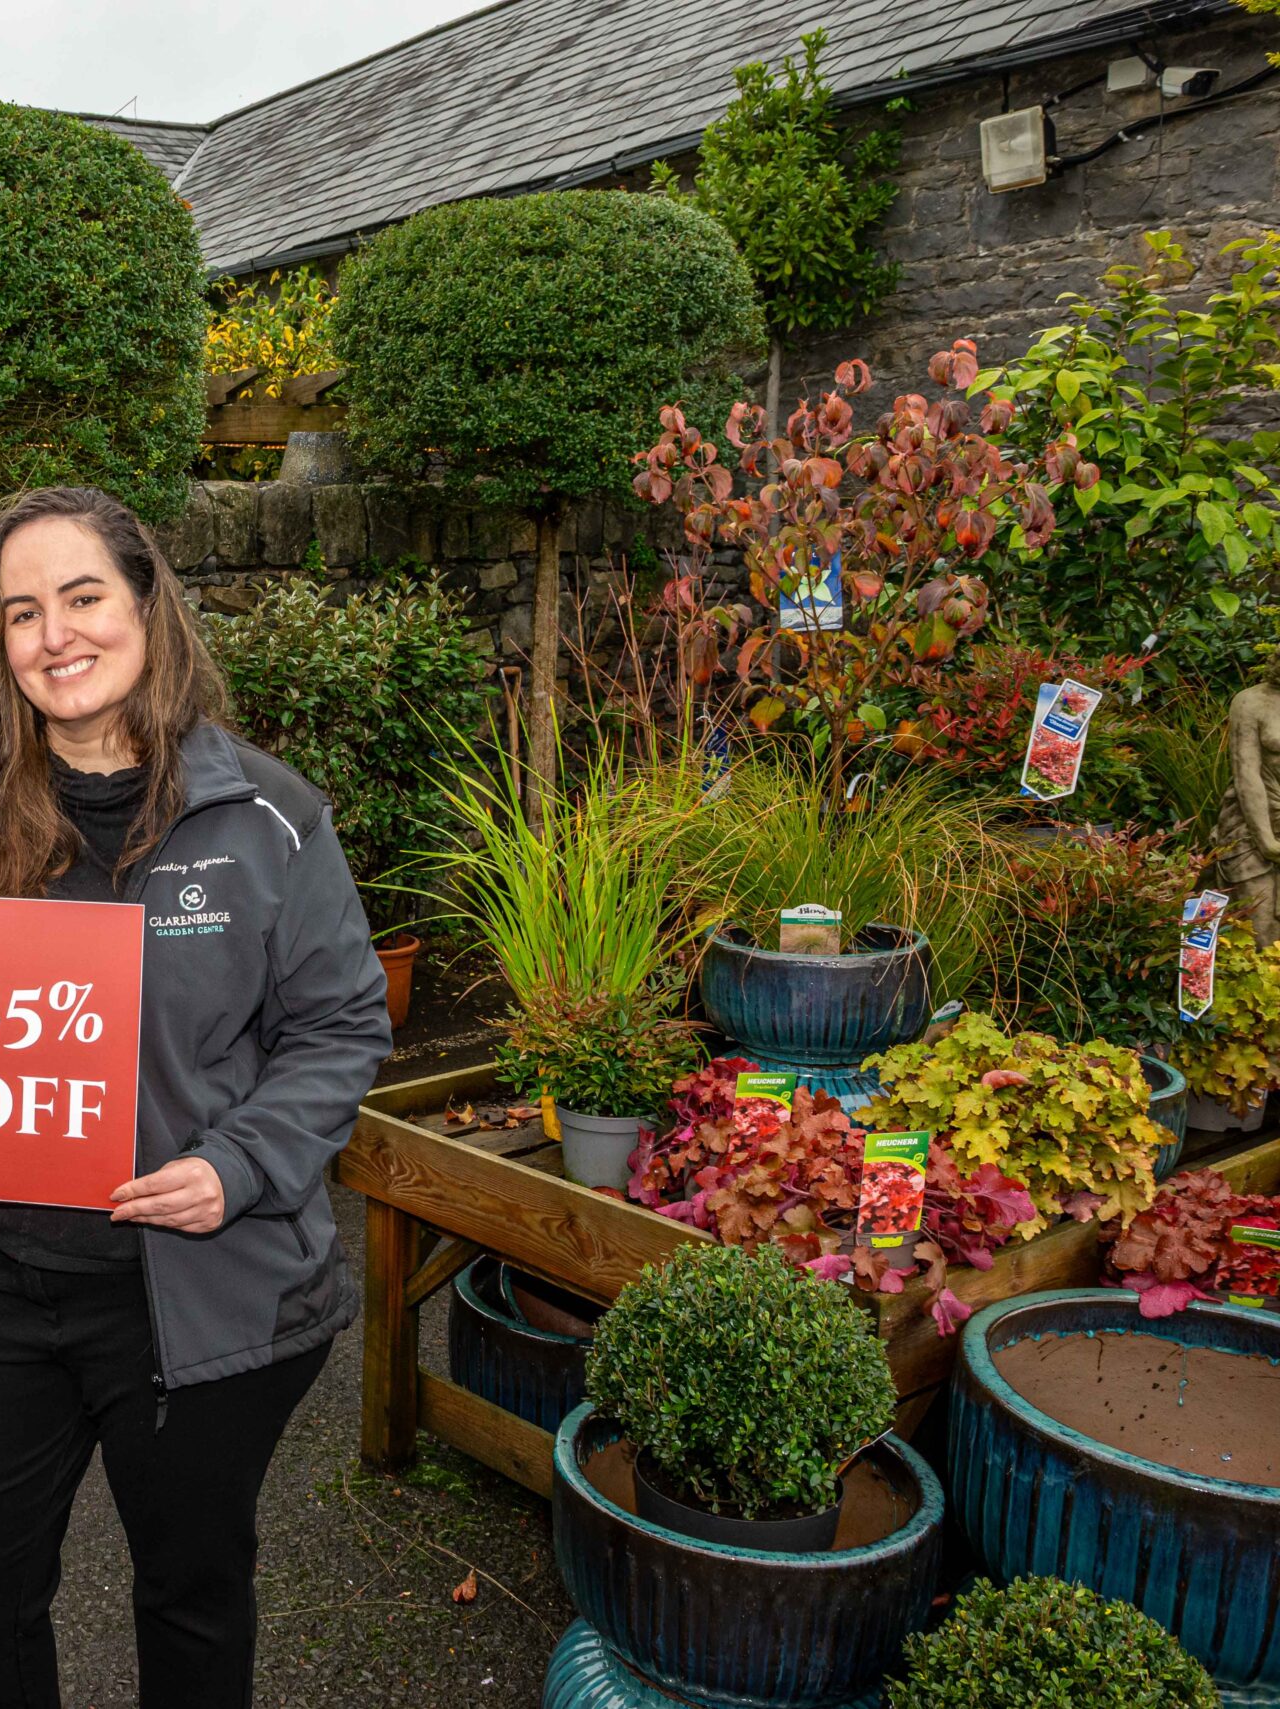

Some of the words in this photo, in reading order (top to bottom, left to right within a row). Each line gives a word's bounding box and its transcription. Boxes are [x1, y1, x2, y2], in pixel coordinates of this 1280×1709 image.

[192, 854, 236, 871] different
[149, 911, 231, 927] CLARENBRIDGE
[156, 927, 194, 936] GARDEN
[197, 925, 224, 934] CENTRE
[876, 1138, 919, 1147] HEUCHERA
